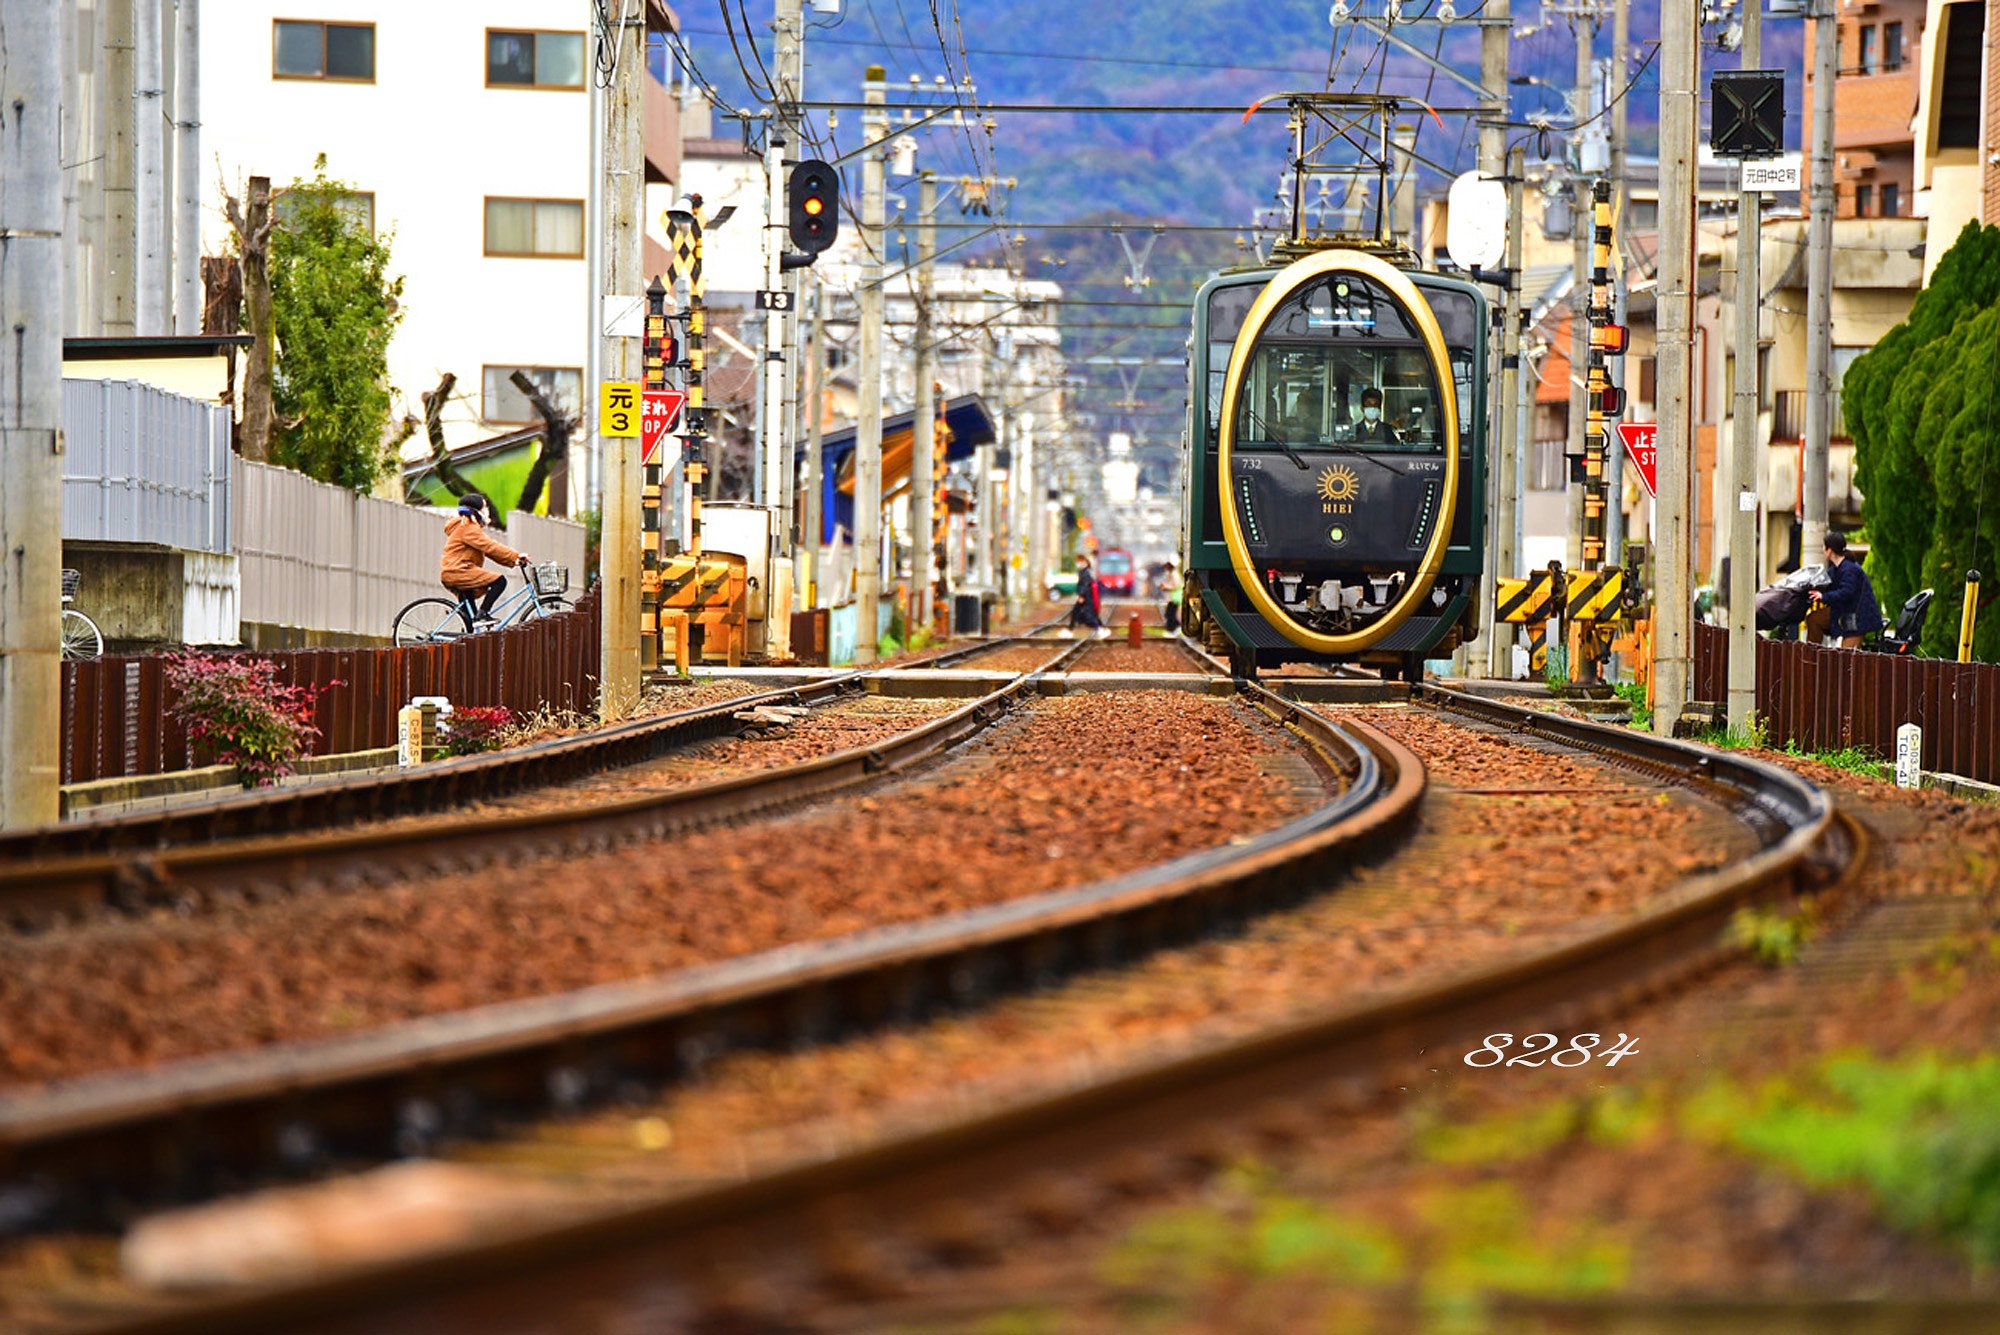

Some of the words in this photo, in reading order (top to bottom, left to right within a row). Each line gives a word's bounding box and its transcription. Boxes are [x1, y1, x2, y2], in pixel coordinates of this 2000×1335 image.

[1746, 168, 1796, 183] 元田中2号
[763, 292, 787, 309] 13
[1242, 458, 1262, 470] 732
[1322, 503, 1352, 514] HIEI
